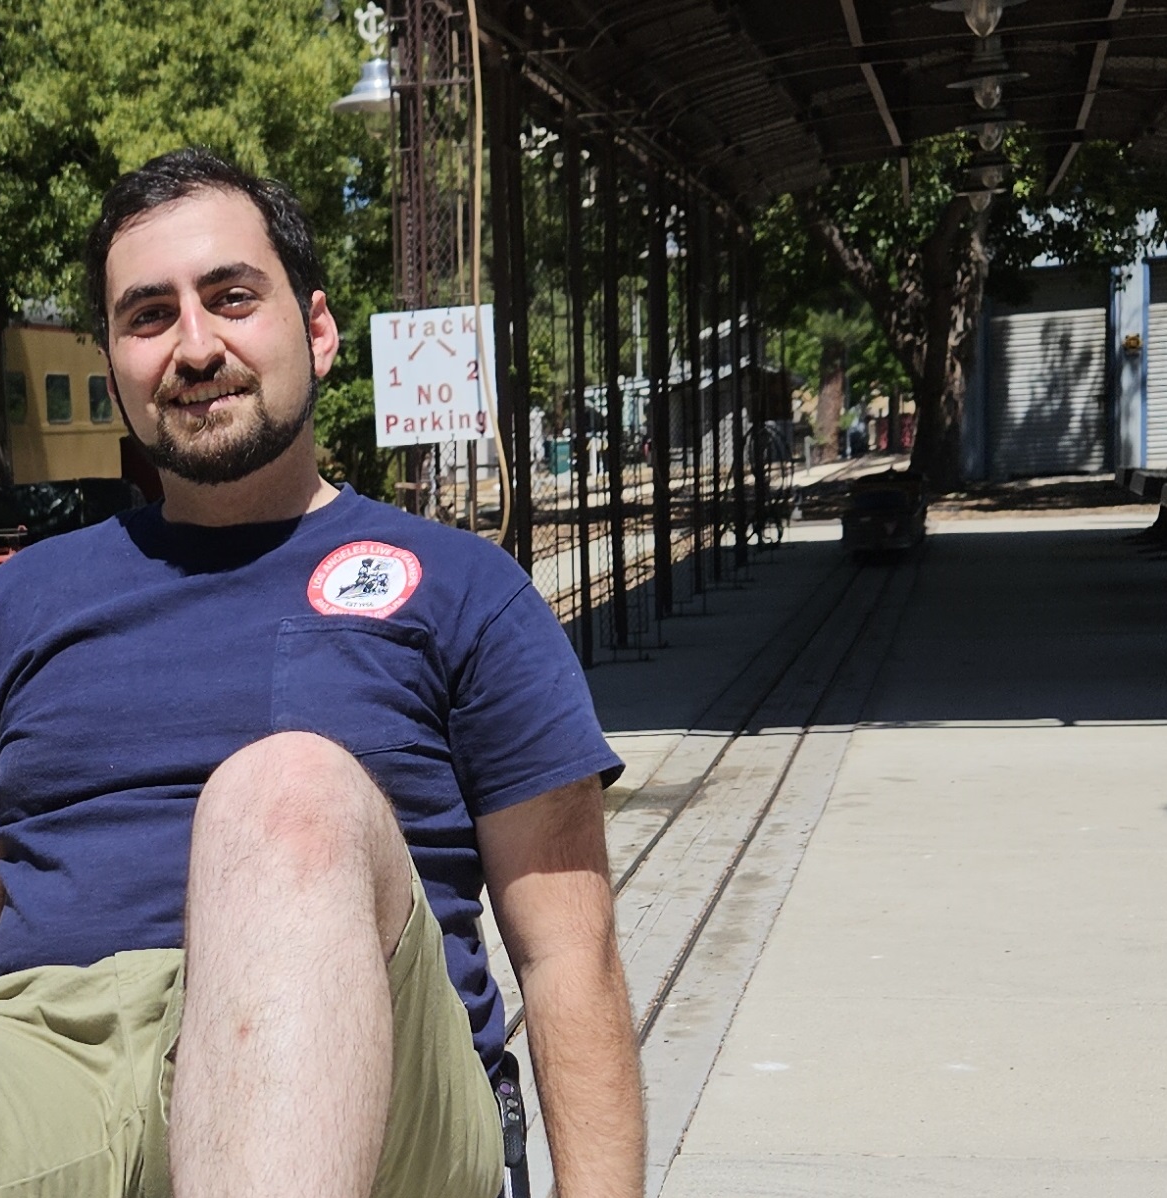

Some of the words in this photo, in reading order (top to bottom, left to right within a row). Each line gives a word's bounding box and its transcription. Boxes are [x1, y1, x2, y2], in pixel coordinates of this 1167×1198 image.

[389, 312, 477, 340] Track
[389, 366, 402, 388] 1
[466, 359, 479, 381] 2
[417, 383, 453, 406] NO
[385, 409, 488, 436] Parking
[312, 572, 326, 589] LOS
[324, 545, 368, 572] ANGELES
[370, 544, 394, 557] LIVE
